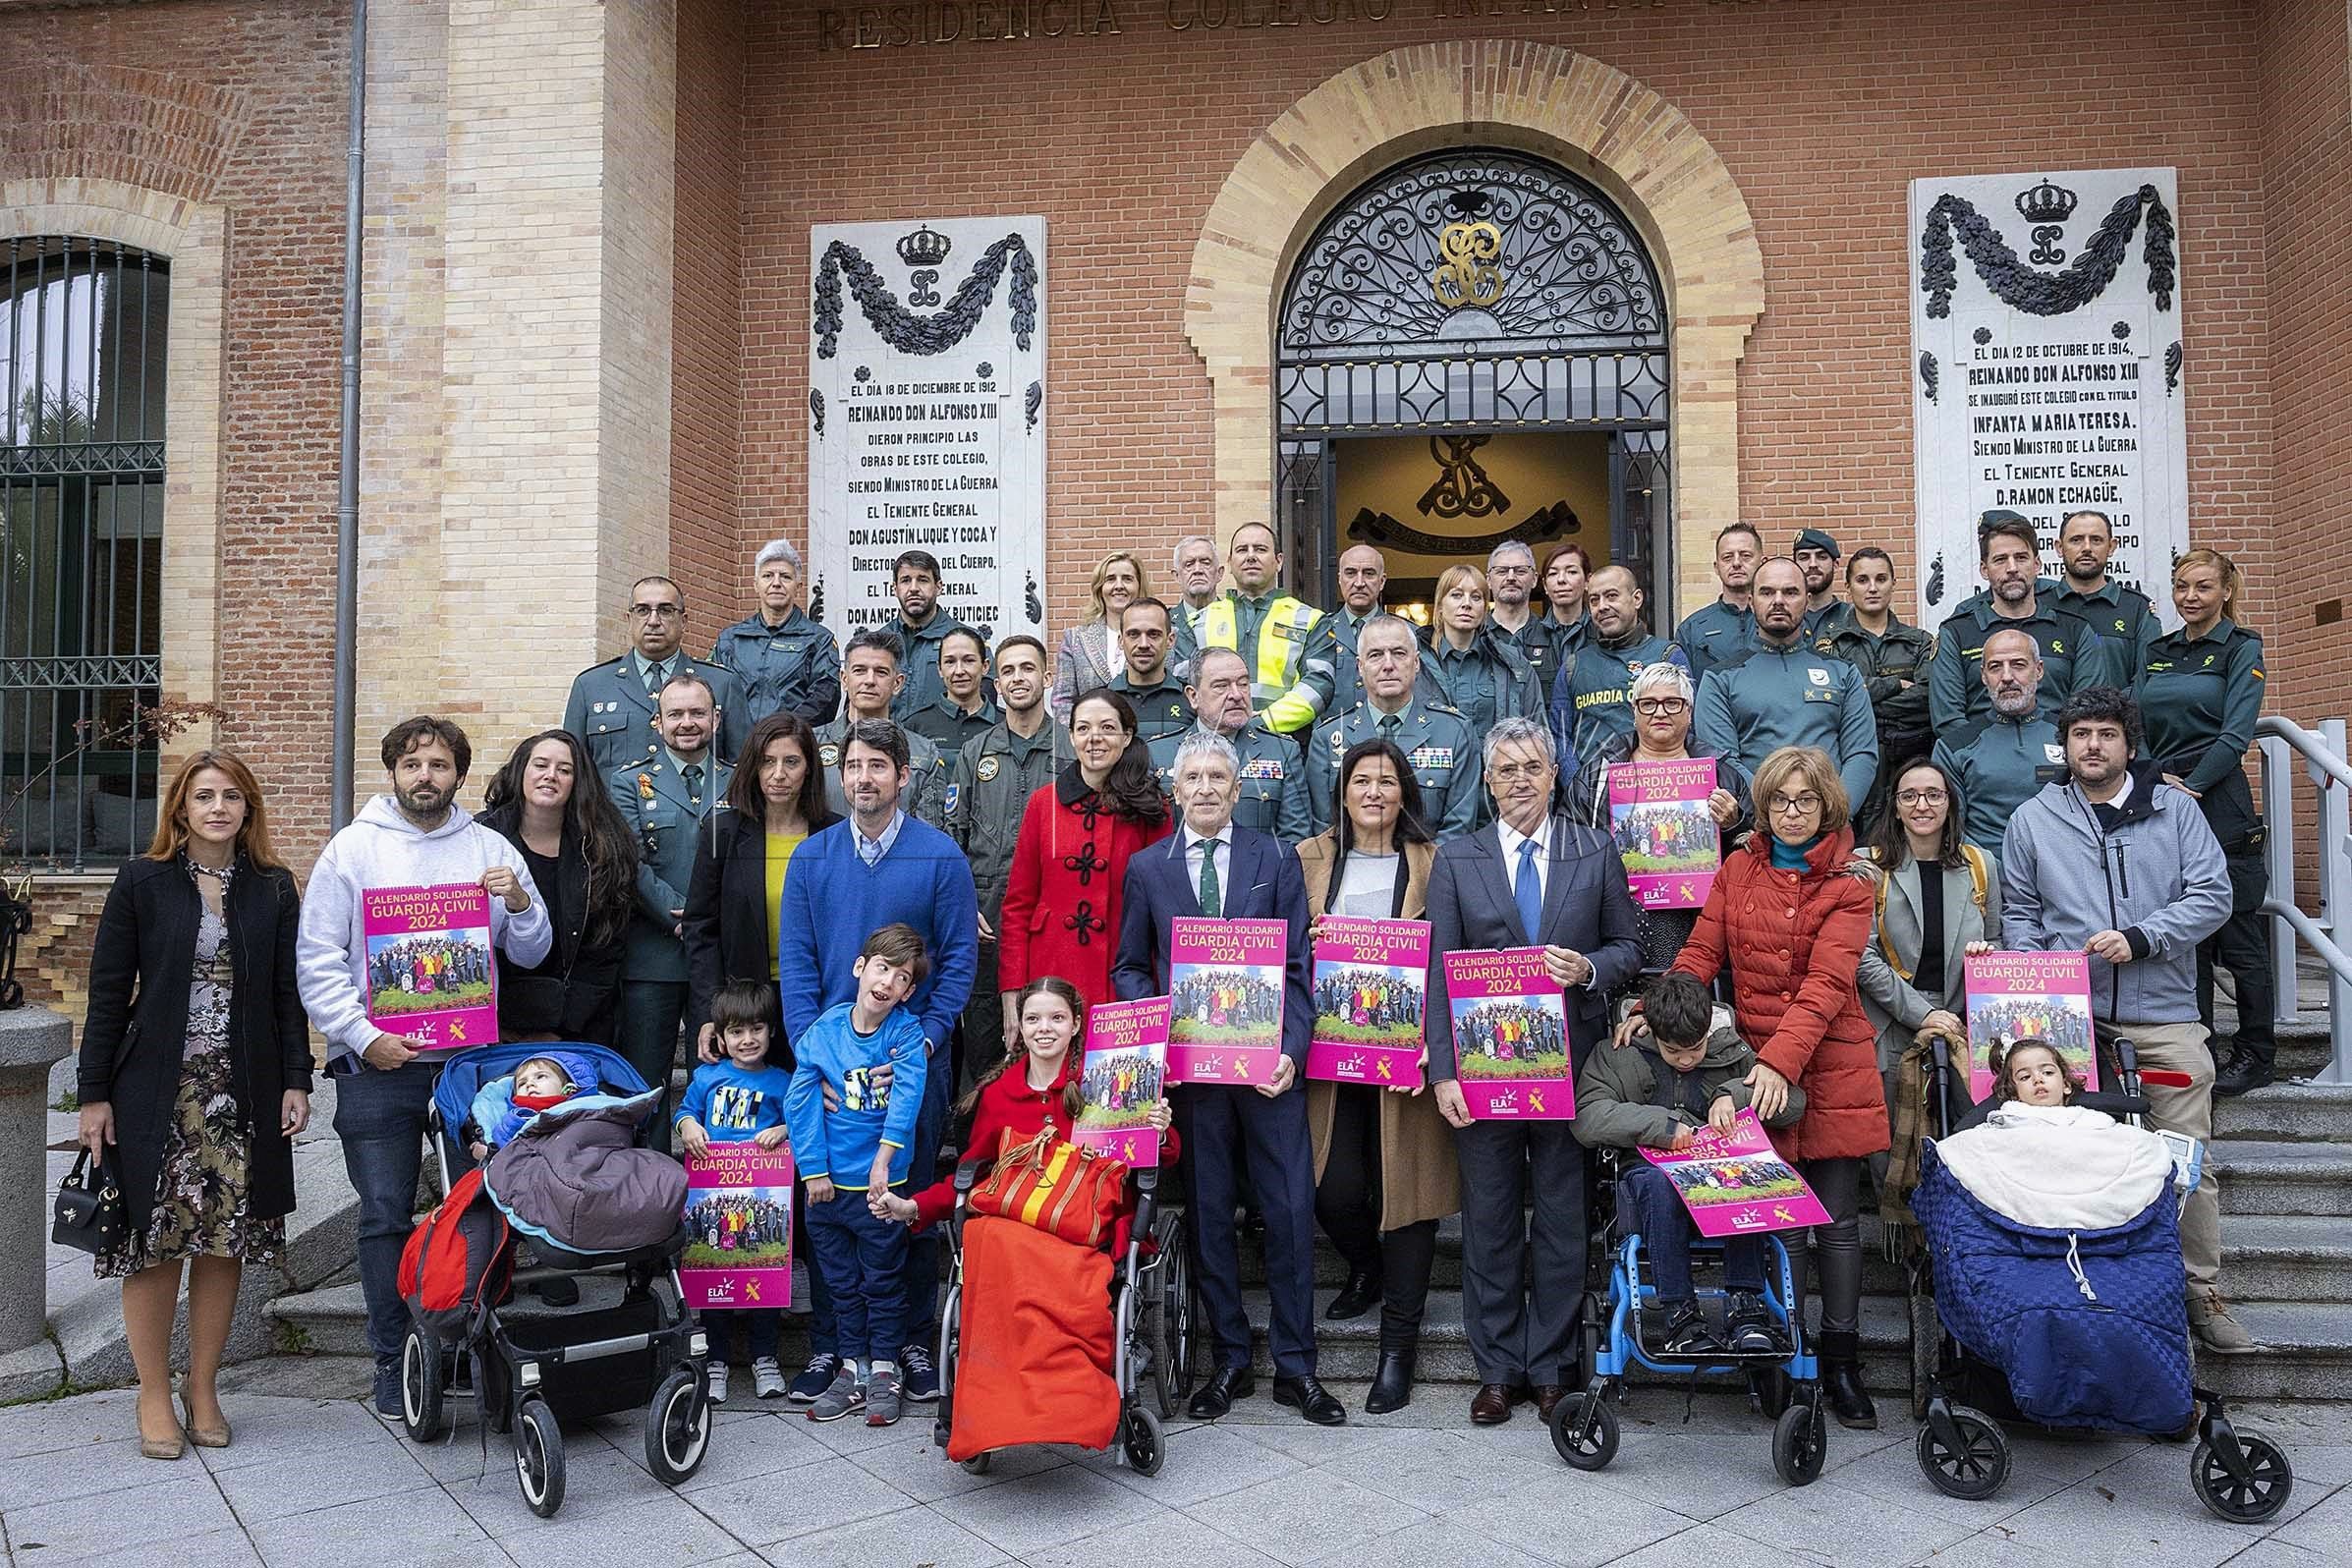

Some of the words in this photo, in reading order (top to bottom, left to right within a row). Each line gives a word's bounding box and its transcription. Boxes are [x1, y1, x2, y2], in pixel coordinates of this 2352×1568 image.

[816, 0, 1122, 50] RESIDENCIA
[1975, 348, 1988, 360] EL
[1992, 347, 2008, 359] DIA
[2013, 347, 2022, 358] 12
[2027, 346, 2039, 358] DE
[2044, 344, 2089, 357] OCTUBRE
[2093, 343, 2104, 355] DE
[2108, 343, 2133, 356] 1914,
[1969, 366, 2029, 385] REINANDO
[2034, 365, 2056, 382] DON
[2062, 364, 2115, 382] ALFONSO
[2121, 363, 2138, 380] XIII
[852, 386, 863, 396] EL
[866, 378, 881, 396] DÍA
[886, 385, 894, 395] 18
[898, 384, 909, 394] DE
[914, 383, 961, 394] DICIEMBRE
[965, 382, 976, 393] DE
[980, 382, 995, 392] 1912
[1969, 395, 1978, 407] SE
[1982, 390, 2018, 406] INAUGURÓ
[2021, 392, 2042, 404] ESTE
[2044, 391, 2076, 403] COLEGIO
[2097, 392, 2105, 401] EL
[2108, 391, 2137, 401] TITULO
[849, 406, 902, 421] REINANDO
[906, 405, 924, 420] DON
[930, 404, 977, 420] ALFONSO
[980, 404, 996, 419] XIII
[1975, 416, 2026, 433] INFANTA
[2033, 414, 2076, 431] MARIA
[2079, 413, 2136, 429] TERESA.
[868, 434, 902, 445] DIERON
[907, 432, 953, 443] PRINCIPIO
[959, 432, 978, 442] LAS
[1975, 440, 2010, 456] SIENDO
[2014, 438, 2062, 455] MINISTRO
[2067, 440, 2078, 453] DE
[2083, 440, 2095, 452] LA
[2099, 436, 2137, 451] GUERRA
[862, 456, 893, 467] OBRAS
[898, 455, 909, 466] DE
[914, 455, 938, 465] ESTE
[943, 453, 987, 464] COLEGIO,
[1985, 469, 2000, 480] EL
[2005, 464, 2065, 479] TENIENTE
[2071, 462, 2128, 477] GENERAL
[849, 481, 881, 493] SIENDO
[884, 477, 928, 491] MINISTRO
[932, 479, 943, 490] DE
[946, 479, 958, 490] LA
[961, 476, 997, 489] GUERRA
[868, 507, 879, 518] EL
[884, 503, 929, 518] TENIENTE
[933, 502, 978, 516] GENERAL
[850, 530, 868, 545] DON
[871, 524, 914, 544] AGUSTÍN
[918, 528, 948, 544] LUQUE
[952, 528, 958, 542] Y
[961, 527, 987, 542] COCA
[990, 527, 996, 541] Y
[942, 558, 957, 569] DEL
[961, 554, 996, 569] CUERPO,
[868, 586, 879, 596] EL
[942, 583, 978, 595] ENERAL
[848, 609, 868, 624] DON
[1576, 689, 1623, 709] GUARDIA
[1612, 766, 1665, 777] CALENDARIO
[1667, 764, 1711, 774] SOLIDARIO
[1616, 777, 1673, 789] GUARDIA
[1677, 773, 1708, 785] CIVIL
[1647, 788, 1679, 799] 2024
[366, 893, 430, 905] CALENDARIO
[433, 889, 483, 900] SOLIDARIO
[1644, 890, 1659, 899] ELA
[371, 903, 440, 918] GUARDIA
[444, 899, 480, 912] CIVIL
[409, 916, 447, 929] 2024
[1176, 924, 1232, 933] CALENDARIO
[1235, 925, 1282, 934] SOLIDARIO
[1322, 922, 1376, 933] CALENDARIO
[1378, 926, 1427, 936] SOLIDARIO
[1179, 934, 1240, 947] GUARDIA
[1244, 936, 1278, 949] CIVIL
[1323, 932, 1383, 947] GUARDIA
[1387, 937, 1421, 951] CIVIL
[1210, 949, 1246, 961] 2024
[1353, 947, 1388, 962] 2024
[1447, 956, 1505, 968] CALENDARIO
[1507, 955, 1545, 964] SOLIDAR
[1453, 967, 1514, 980] GUARDIA
[1518, 965, 1551, 978] CIVIL
[1974, 967, 2039, 978] GUARDIA
[2043, 968, 2080, 978] CIVIL
[1486, 980, 1523, 993] 2024
[2007, 980, 2045, 990] 2024
[1092, 1009, 1134, 1022] CALENDARIO
[1135, 1003, 1169, 1017] SOLIDARIO
[1092, 1020, 1138, 1034] GUARDIA
[1140, 1014, 1163, 1029] CIVIL
[1114, 1031, 1141, 1045] 2024
[1195, 1063, 1211, 1072] ELA
[1337, 1062, 1355, 1071] ELA
[1490, 1099, 1507, 1108] ELA
[743, 1148, 791, 1156] SOLIDARIO
[1652, 1143, 1717, 1158] GUARDIA
[1690, 1149, 1729, 1159] 2024
[692, 1158, 748, 1171] GUARDIA
[752, 1157, 786, 1170] CIVIL
[718, 1171, 754, 1184] 2024
[1730, 1214, 1751, 1225] ELA
[708, 1288, 723, 1297] ELA
